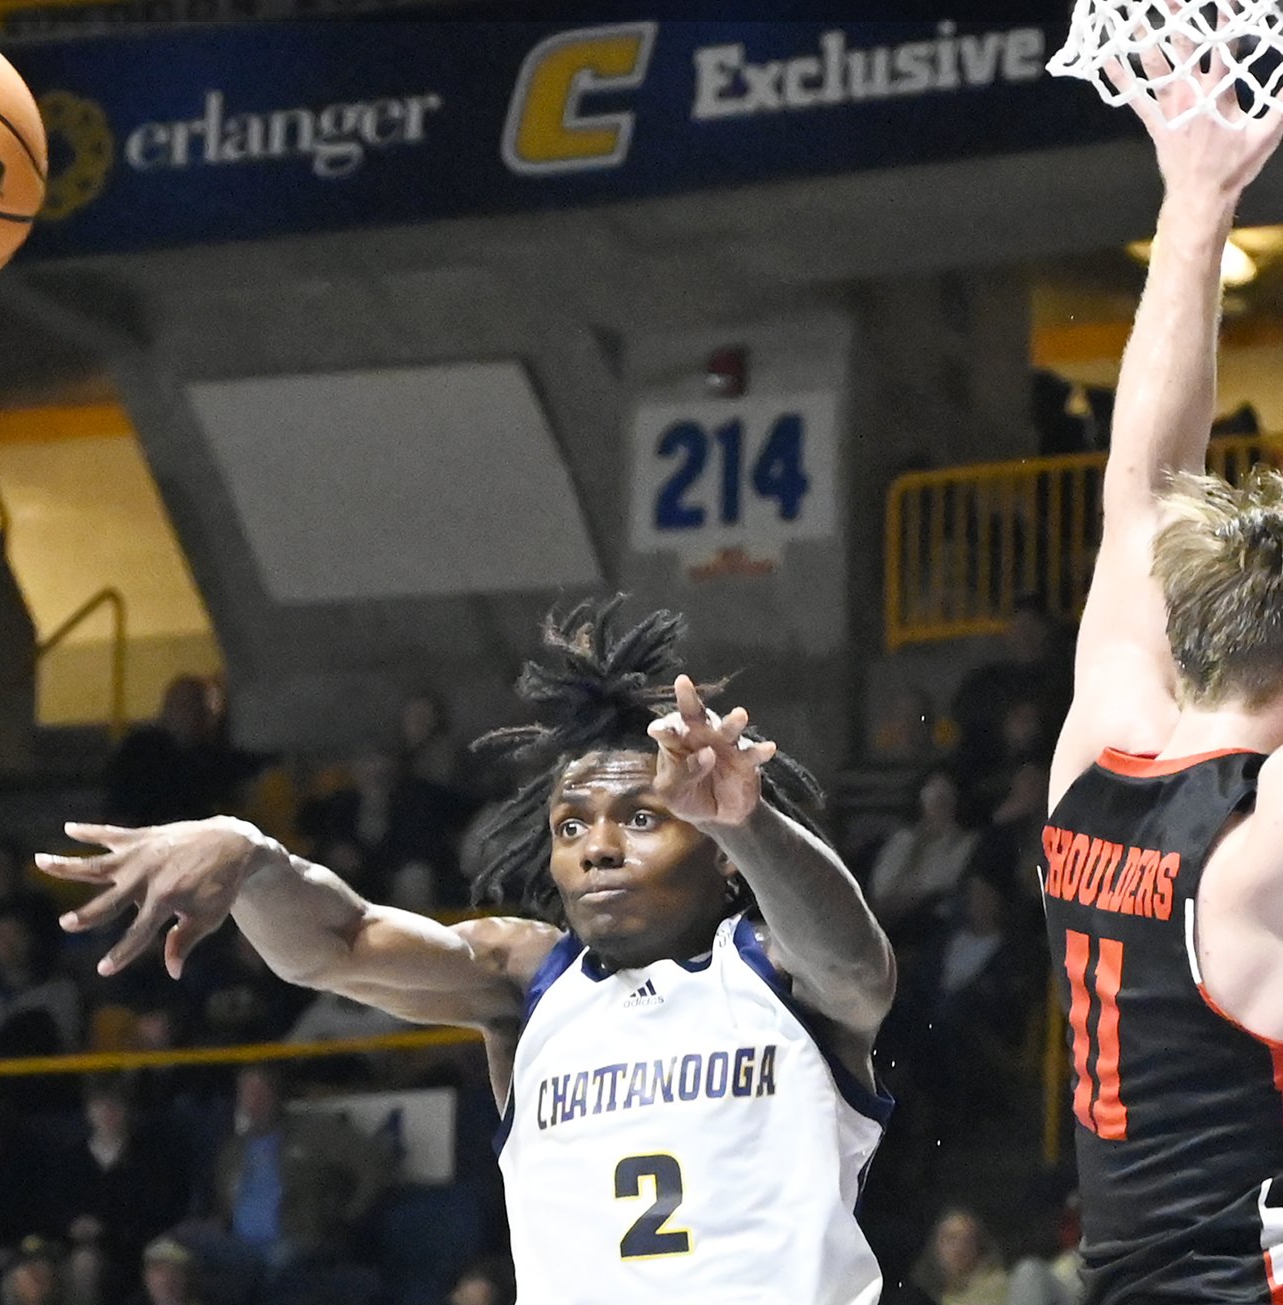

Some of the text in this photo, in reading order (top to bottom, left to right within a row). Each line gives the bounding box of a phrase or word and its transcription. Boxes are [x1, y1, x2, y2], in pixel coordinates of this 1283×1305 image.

[500, 22, 658, 177] C
[690, 20, 1045, 120] Exclusive
[125, 88, 443, 178] erlanger
[655, 412, 811, 531] 214
[623, 995, 665, 1009] adidas
[1064, 928, 1128, 1142] 11
[537, 1045, 778, 1131] CHATTANOOGA
[614, 1150, 693, 1262] 2
